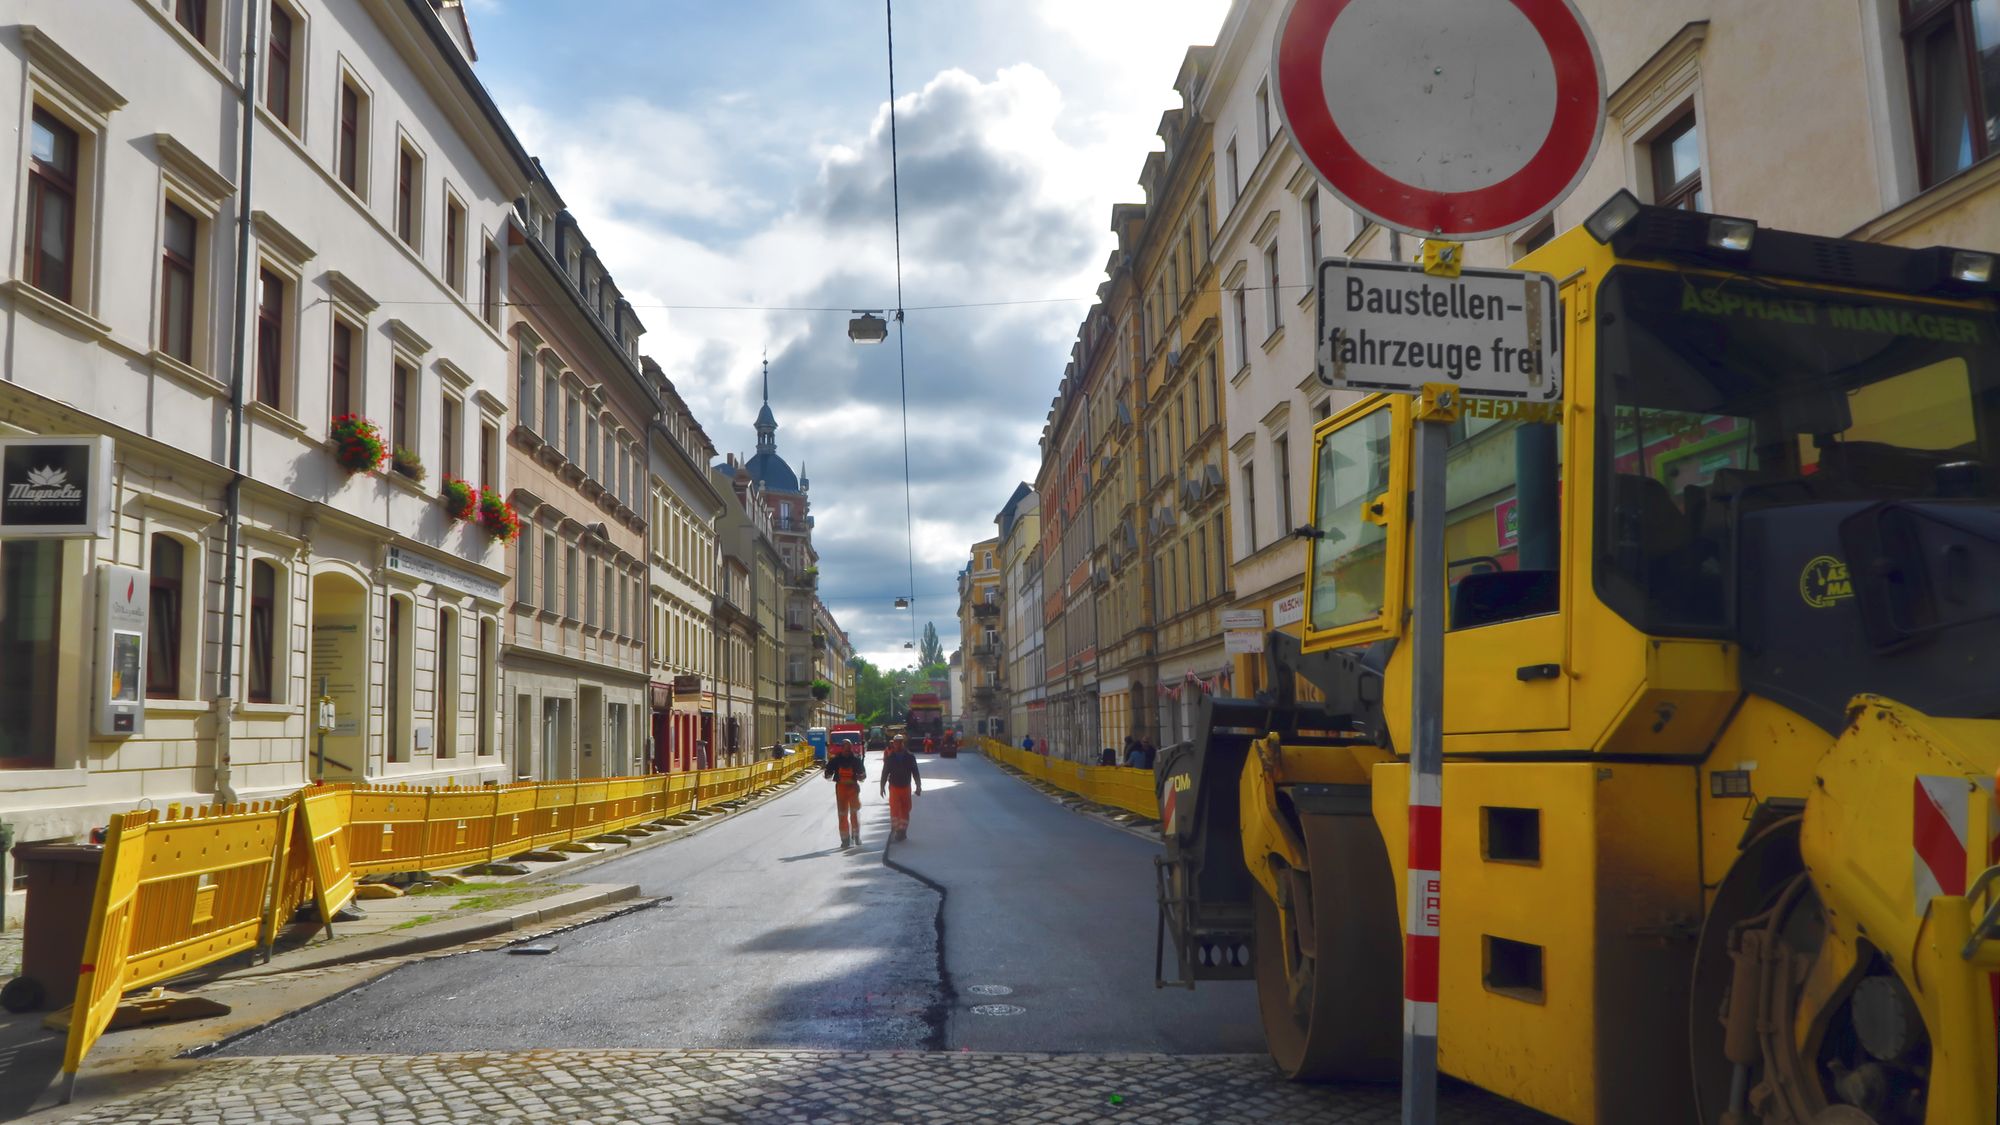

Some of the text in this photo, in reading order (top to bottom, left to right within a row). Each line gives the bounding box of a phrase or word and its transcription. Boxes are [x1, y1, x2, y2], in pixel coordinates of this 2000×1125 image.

[1346, 276, 1523, 321] Baustellen-
[1682, 284, 1981, 343] ASPHALT MANAGER
[1329, 327, 1543, 380] fahrzeuge frei
[9, 483, 82, 502] Magnolia
[1827, 566, 1849, 581] AS
[1827, 580, 1853, 595] MA
